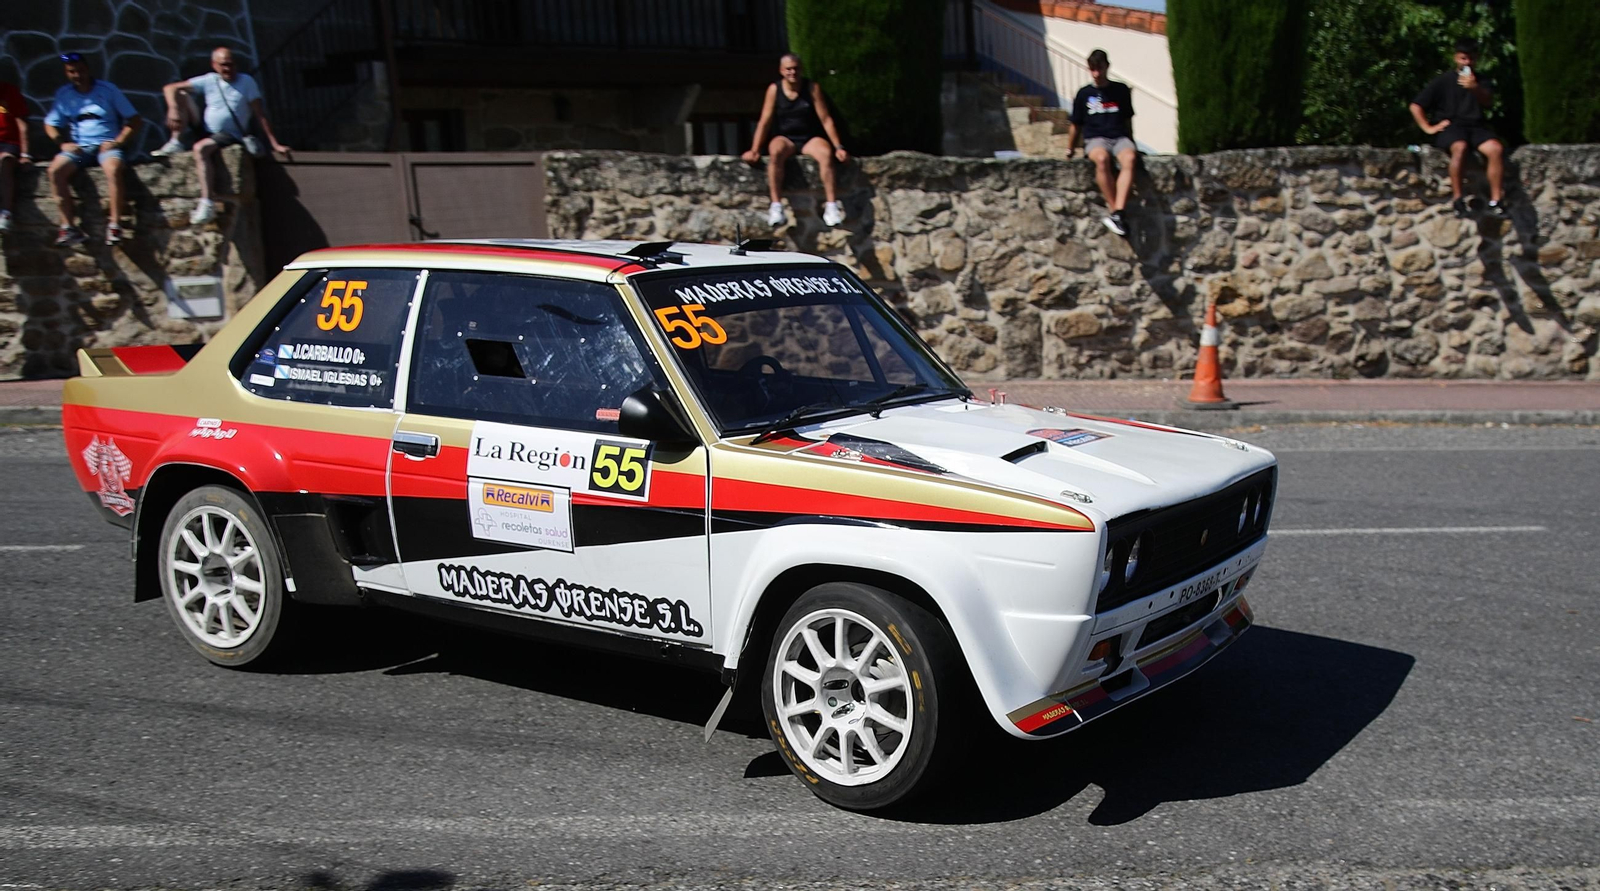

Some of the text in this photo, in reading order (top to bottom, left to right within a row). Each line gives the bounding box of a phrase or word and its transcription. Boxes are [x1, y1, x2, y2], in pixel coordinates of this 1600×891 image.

[674, 278, 773, 304] MADERAS
[316, 280, 368, 332] 55
[653, 303, 728, 349] 55
[293, 343, 352, 364] J.CARBALLO
[289, 367, 322, 382] ISMAEL
[323, 370, 367, 387] IGLESIAS
[473, 437, 586, 472] La Región
[592, 445, 646, 491] 55
[496, 489, 540, 507] Recalvi
[500, 511, 532, 521] HOSPITAL
[501, 521, 569, 539] recoletas salud
[538, 537, 570, 549] OURENSE
[440, 566, 549, 609] MADERAS
